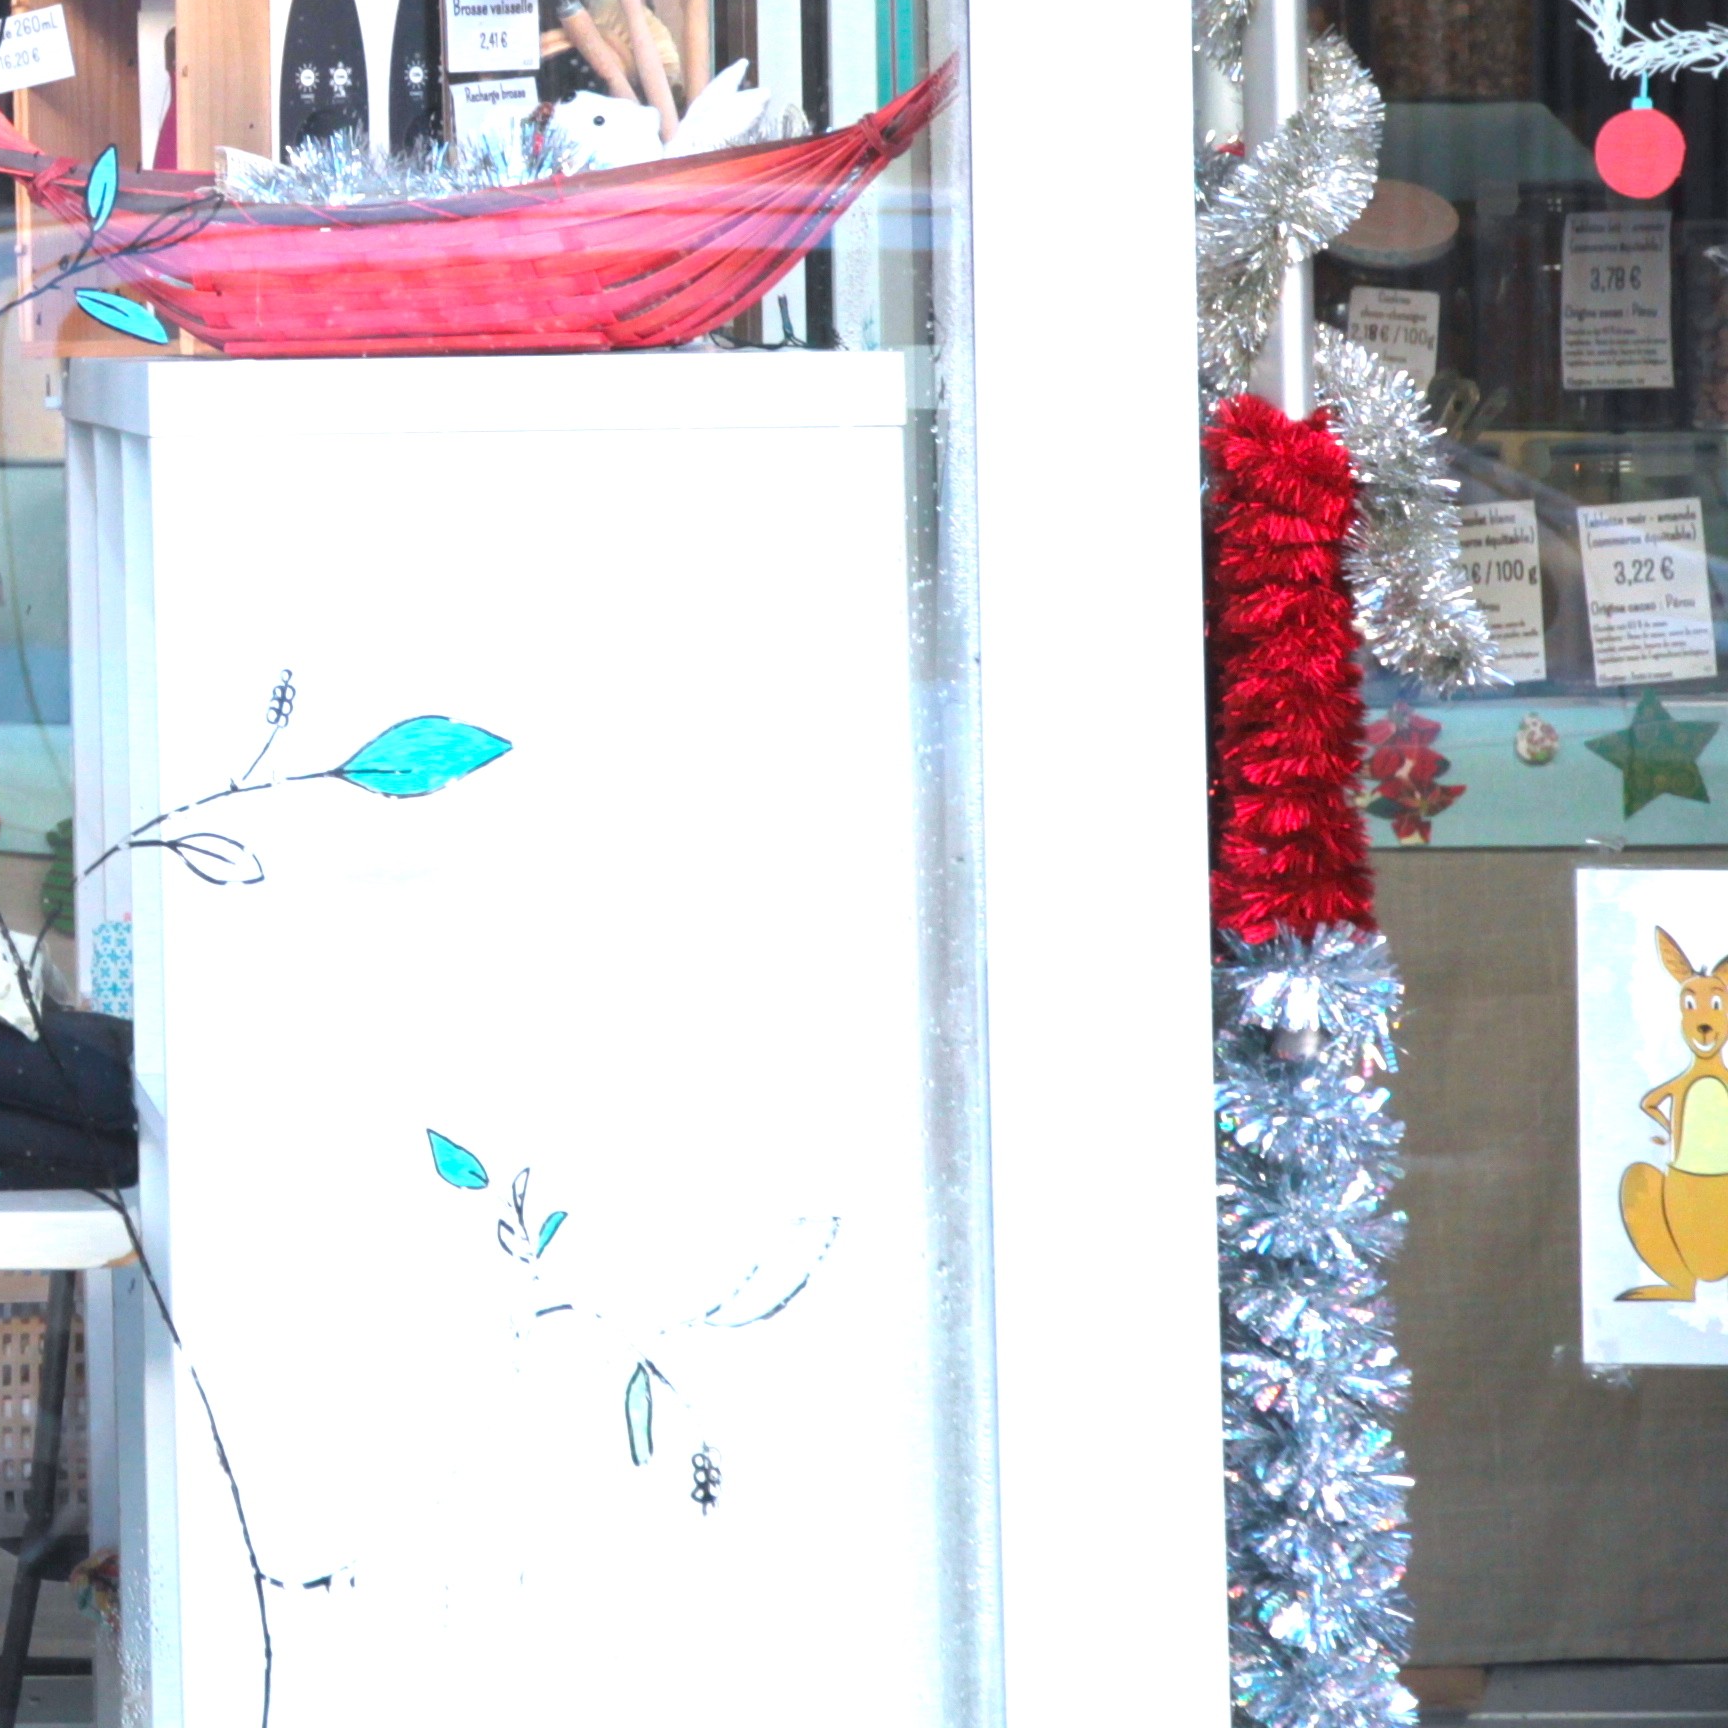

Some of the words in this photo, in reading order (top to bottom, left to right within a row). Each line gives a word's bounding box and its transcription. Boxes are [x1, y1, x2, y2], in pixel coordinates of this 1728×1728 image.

[14, 11, 59, 38] 260mL
[479, 32, 499, 50] 2,41
[500, 31, 508, 48] €
[0, 50, 30, 70] 16,20
[32, 47, 41, 63] €
[464, 84, 500, 104] Recharge
[500, 83, 527, 99] brosse
[1629, 264, 1642, 290] €
[1613, 557, 1656, 586] 3,22
[1659, 555, 1675, 581] €
